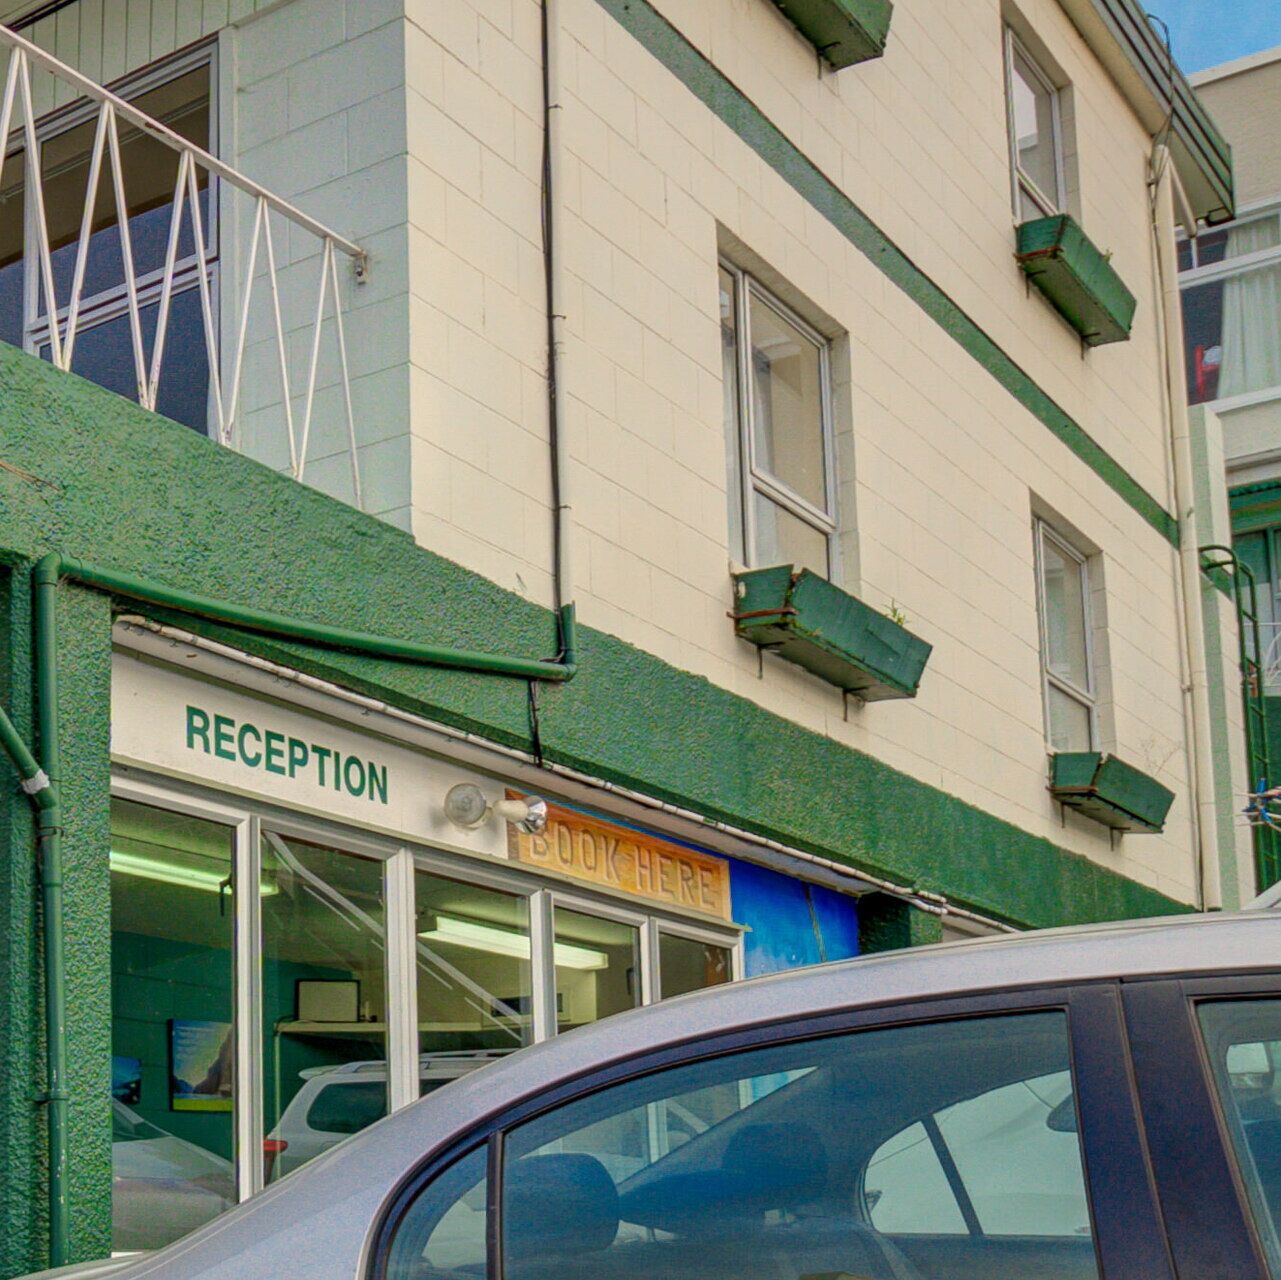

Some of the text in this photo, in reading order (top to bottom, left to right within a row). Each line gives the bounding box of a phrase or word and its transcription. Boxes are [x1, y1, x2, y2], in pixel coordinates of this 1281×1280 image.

[186, 705, 389, 805] RECEPTION
[529, 820, 716, 908] BOOK HERE
